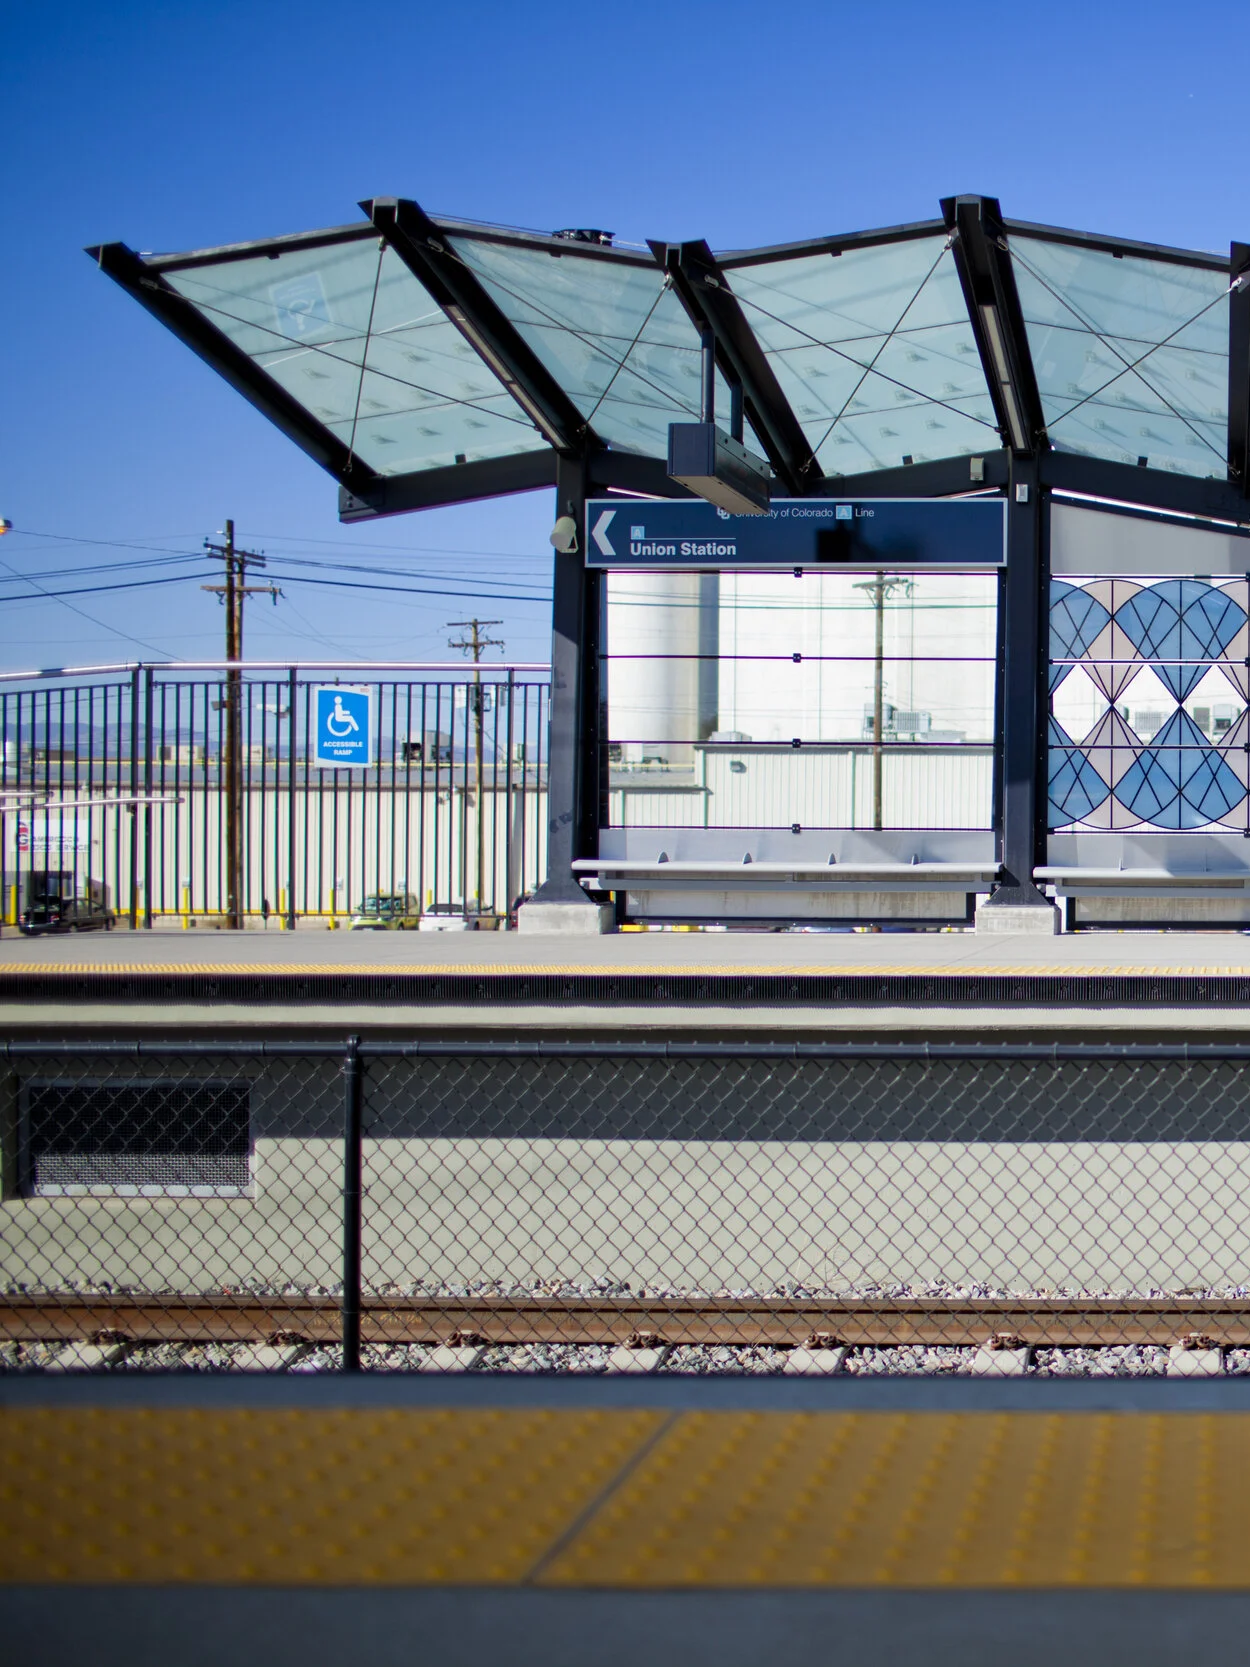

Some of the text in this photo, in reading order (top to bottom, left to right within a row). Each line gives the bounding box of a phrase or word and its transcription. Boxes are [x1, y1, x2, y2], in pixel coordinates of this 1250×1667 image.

[780, 508, 790, 518] of
[791, 508, 834, 518] Colorado
[855, 508, 875, 518] Line
[630, 542, 737, 556] Union Station
